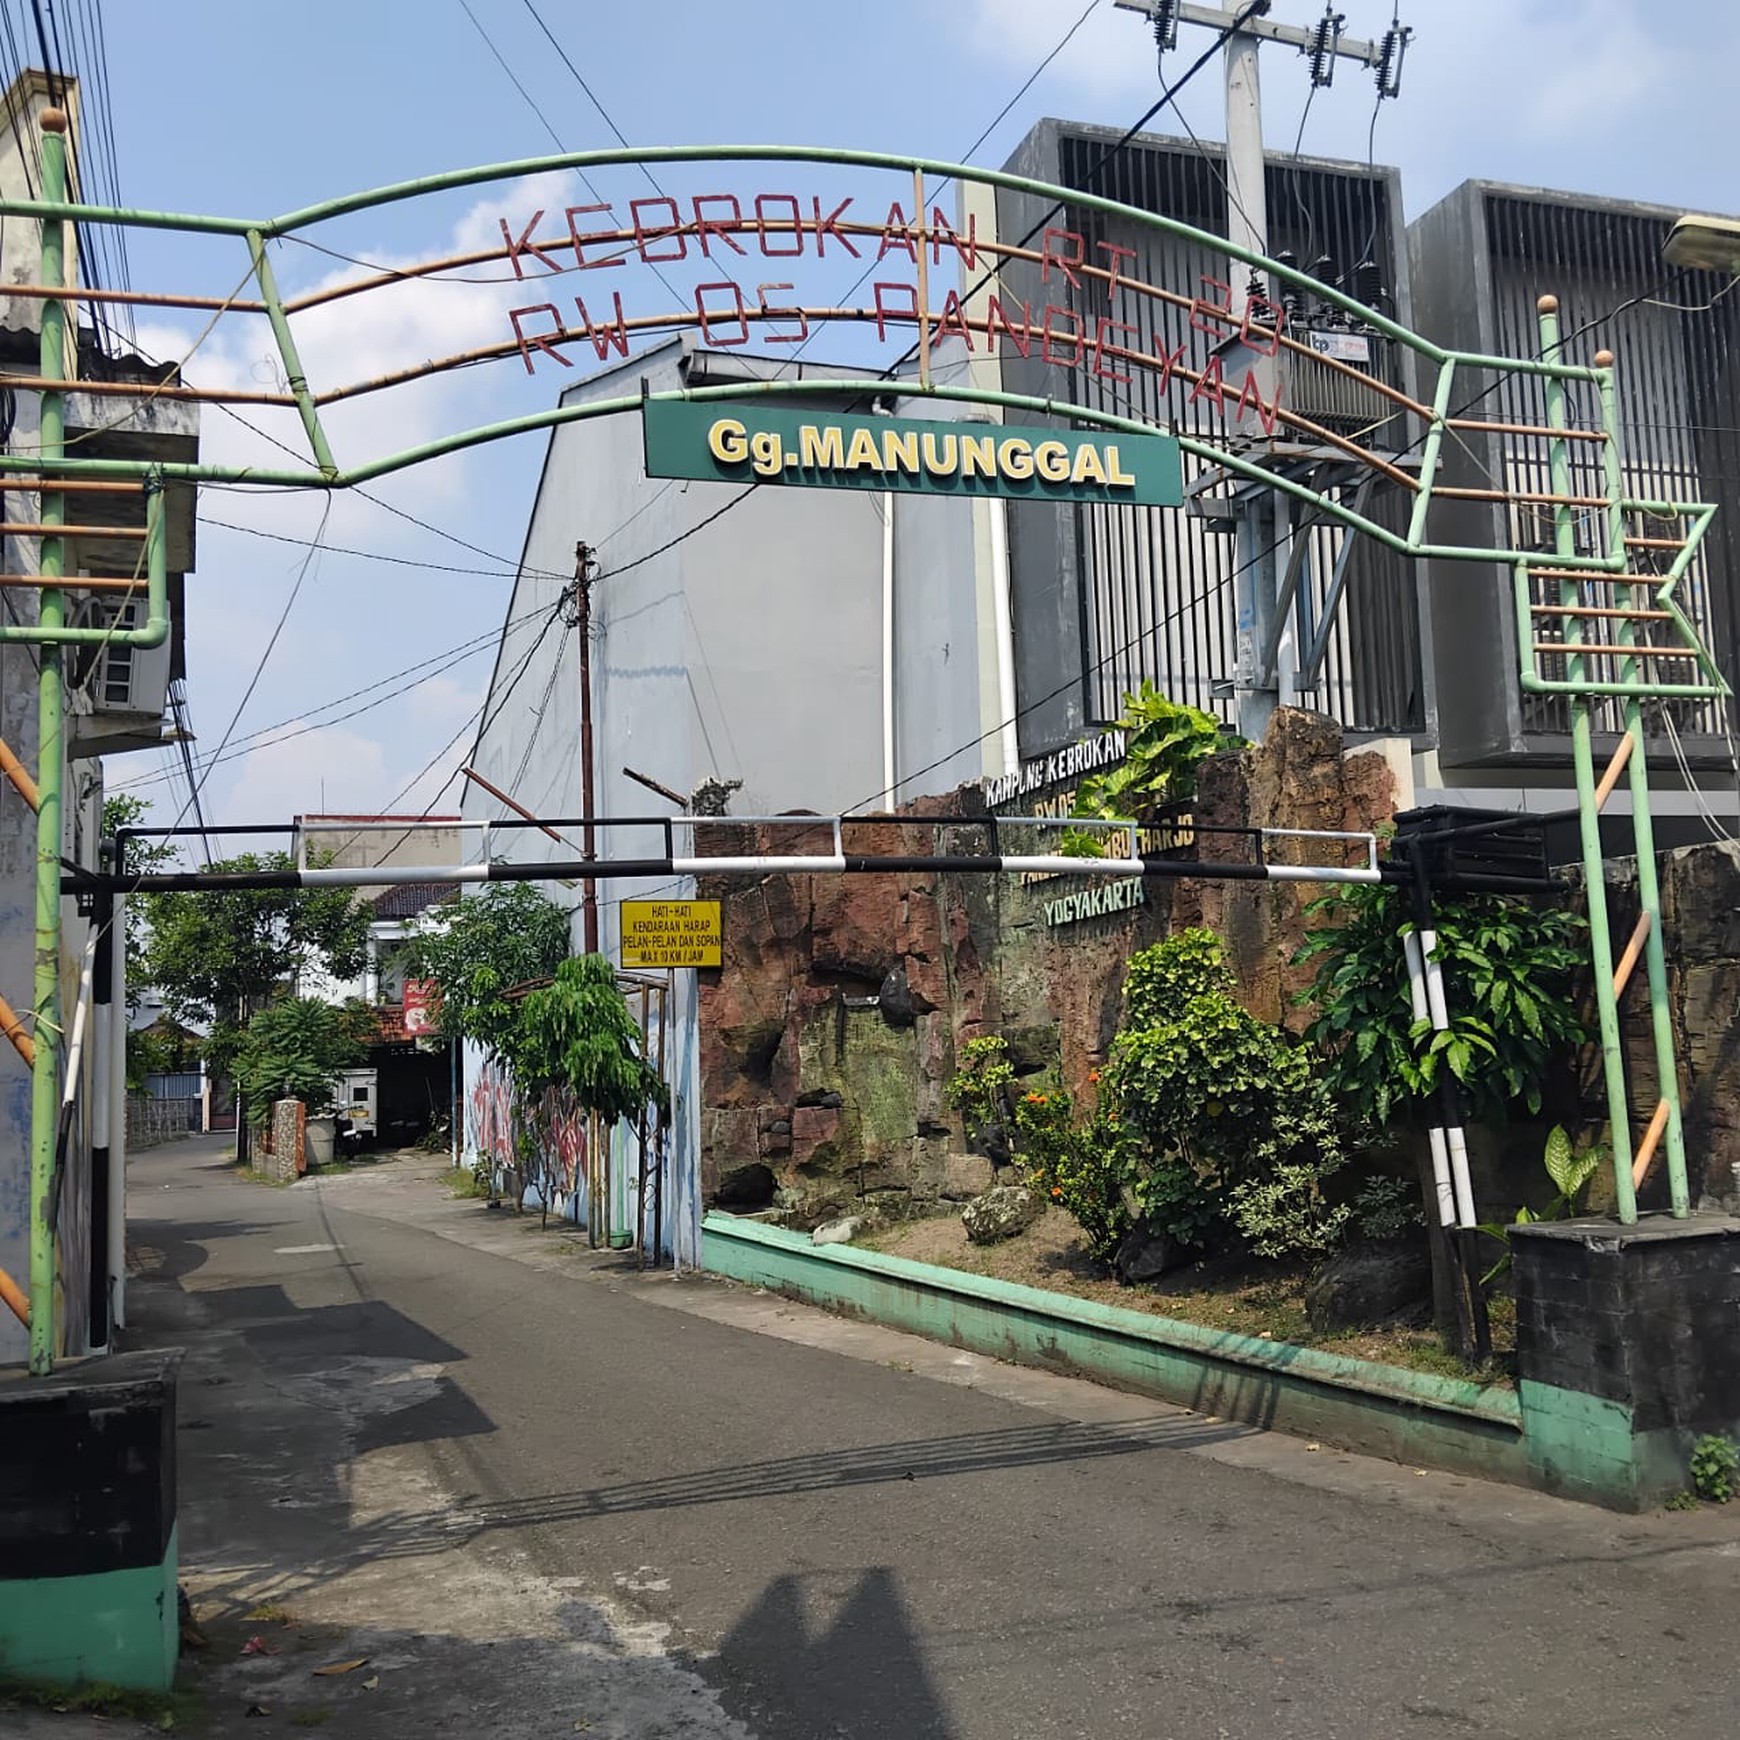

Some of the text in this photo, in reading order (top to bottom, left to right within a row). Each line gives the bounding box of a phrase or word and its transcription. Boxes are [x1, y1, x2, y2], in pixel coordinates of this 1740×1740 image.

[499, 194, 1284, 358] KEBROKAN RT 20
[509, 281, 1285, 436] RW 05 PANDEYAN
[708, 418, 1137, 487] Gg.MANUNGGAL
[1047, 728, 1125, 783] KEBROKAN
[633, 919, 711, 933] KENDARAAN HARAP
[651, 905, 692, 918] HATI-HATI
[1043, 876, 1144, 926] YOGYAKARTA
[679, 935, 694, 947] DAN
